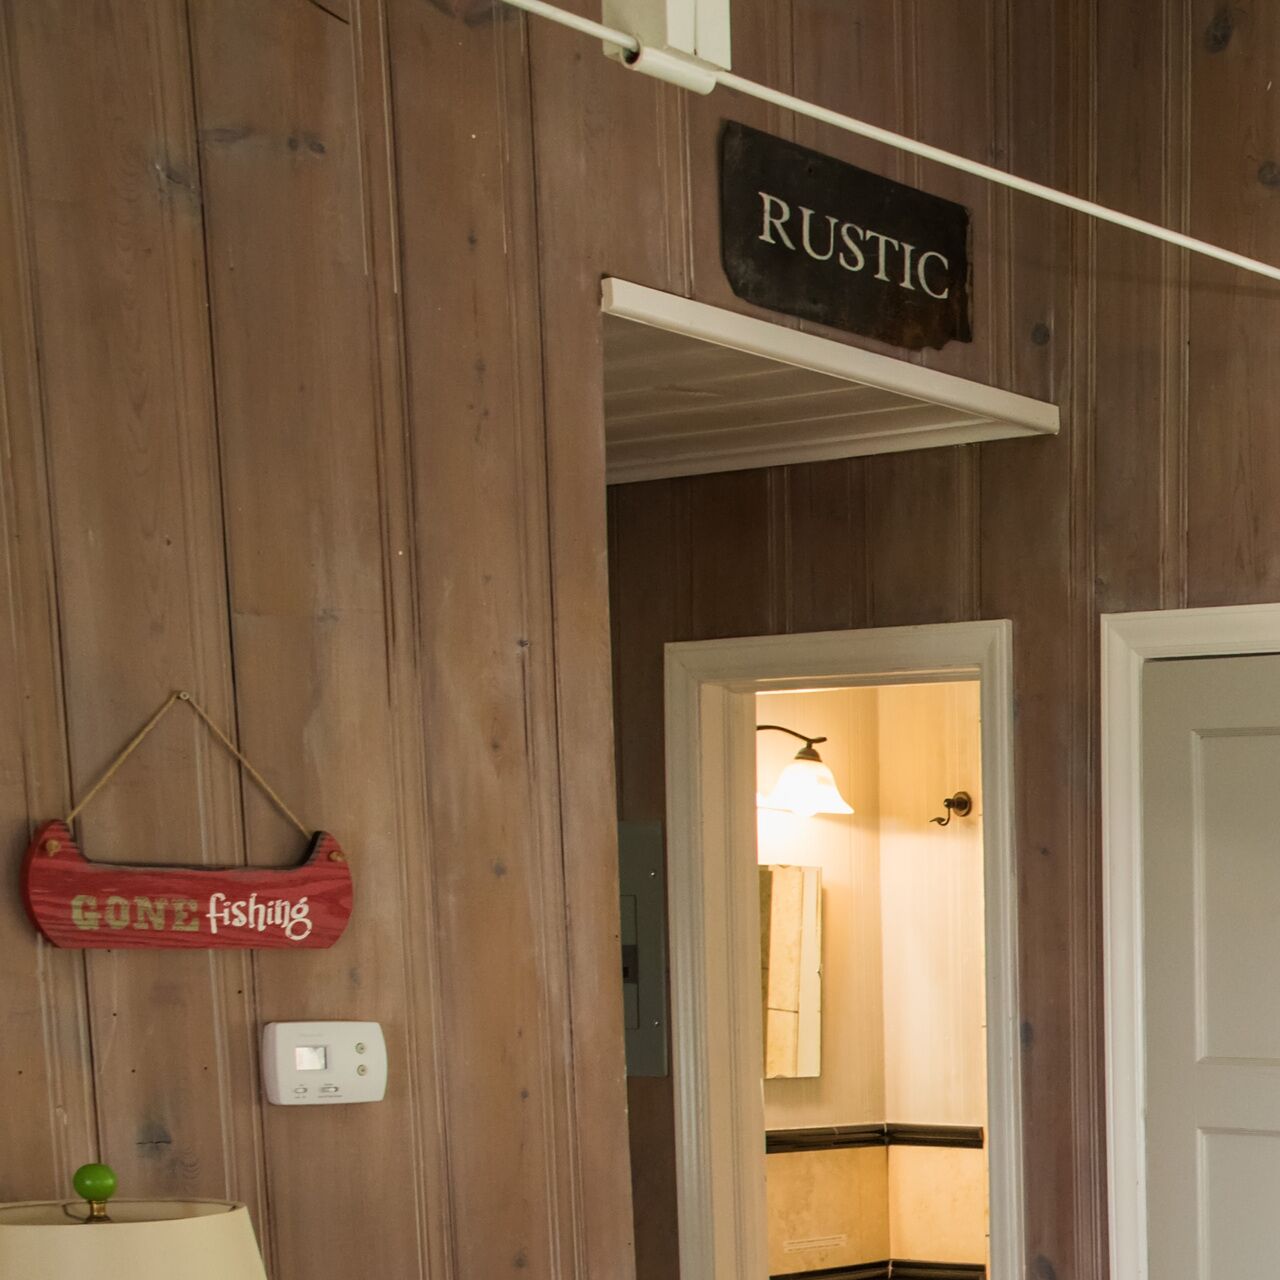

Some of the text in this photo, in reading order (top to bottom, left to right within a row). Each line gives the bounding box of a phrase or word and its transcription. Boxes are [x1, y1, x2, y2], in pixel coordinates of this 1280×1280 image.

[758, 191, 949, 299] RUSTIC
[70, 892, 312, 940] GONE fishing
